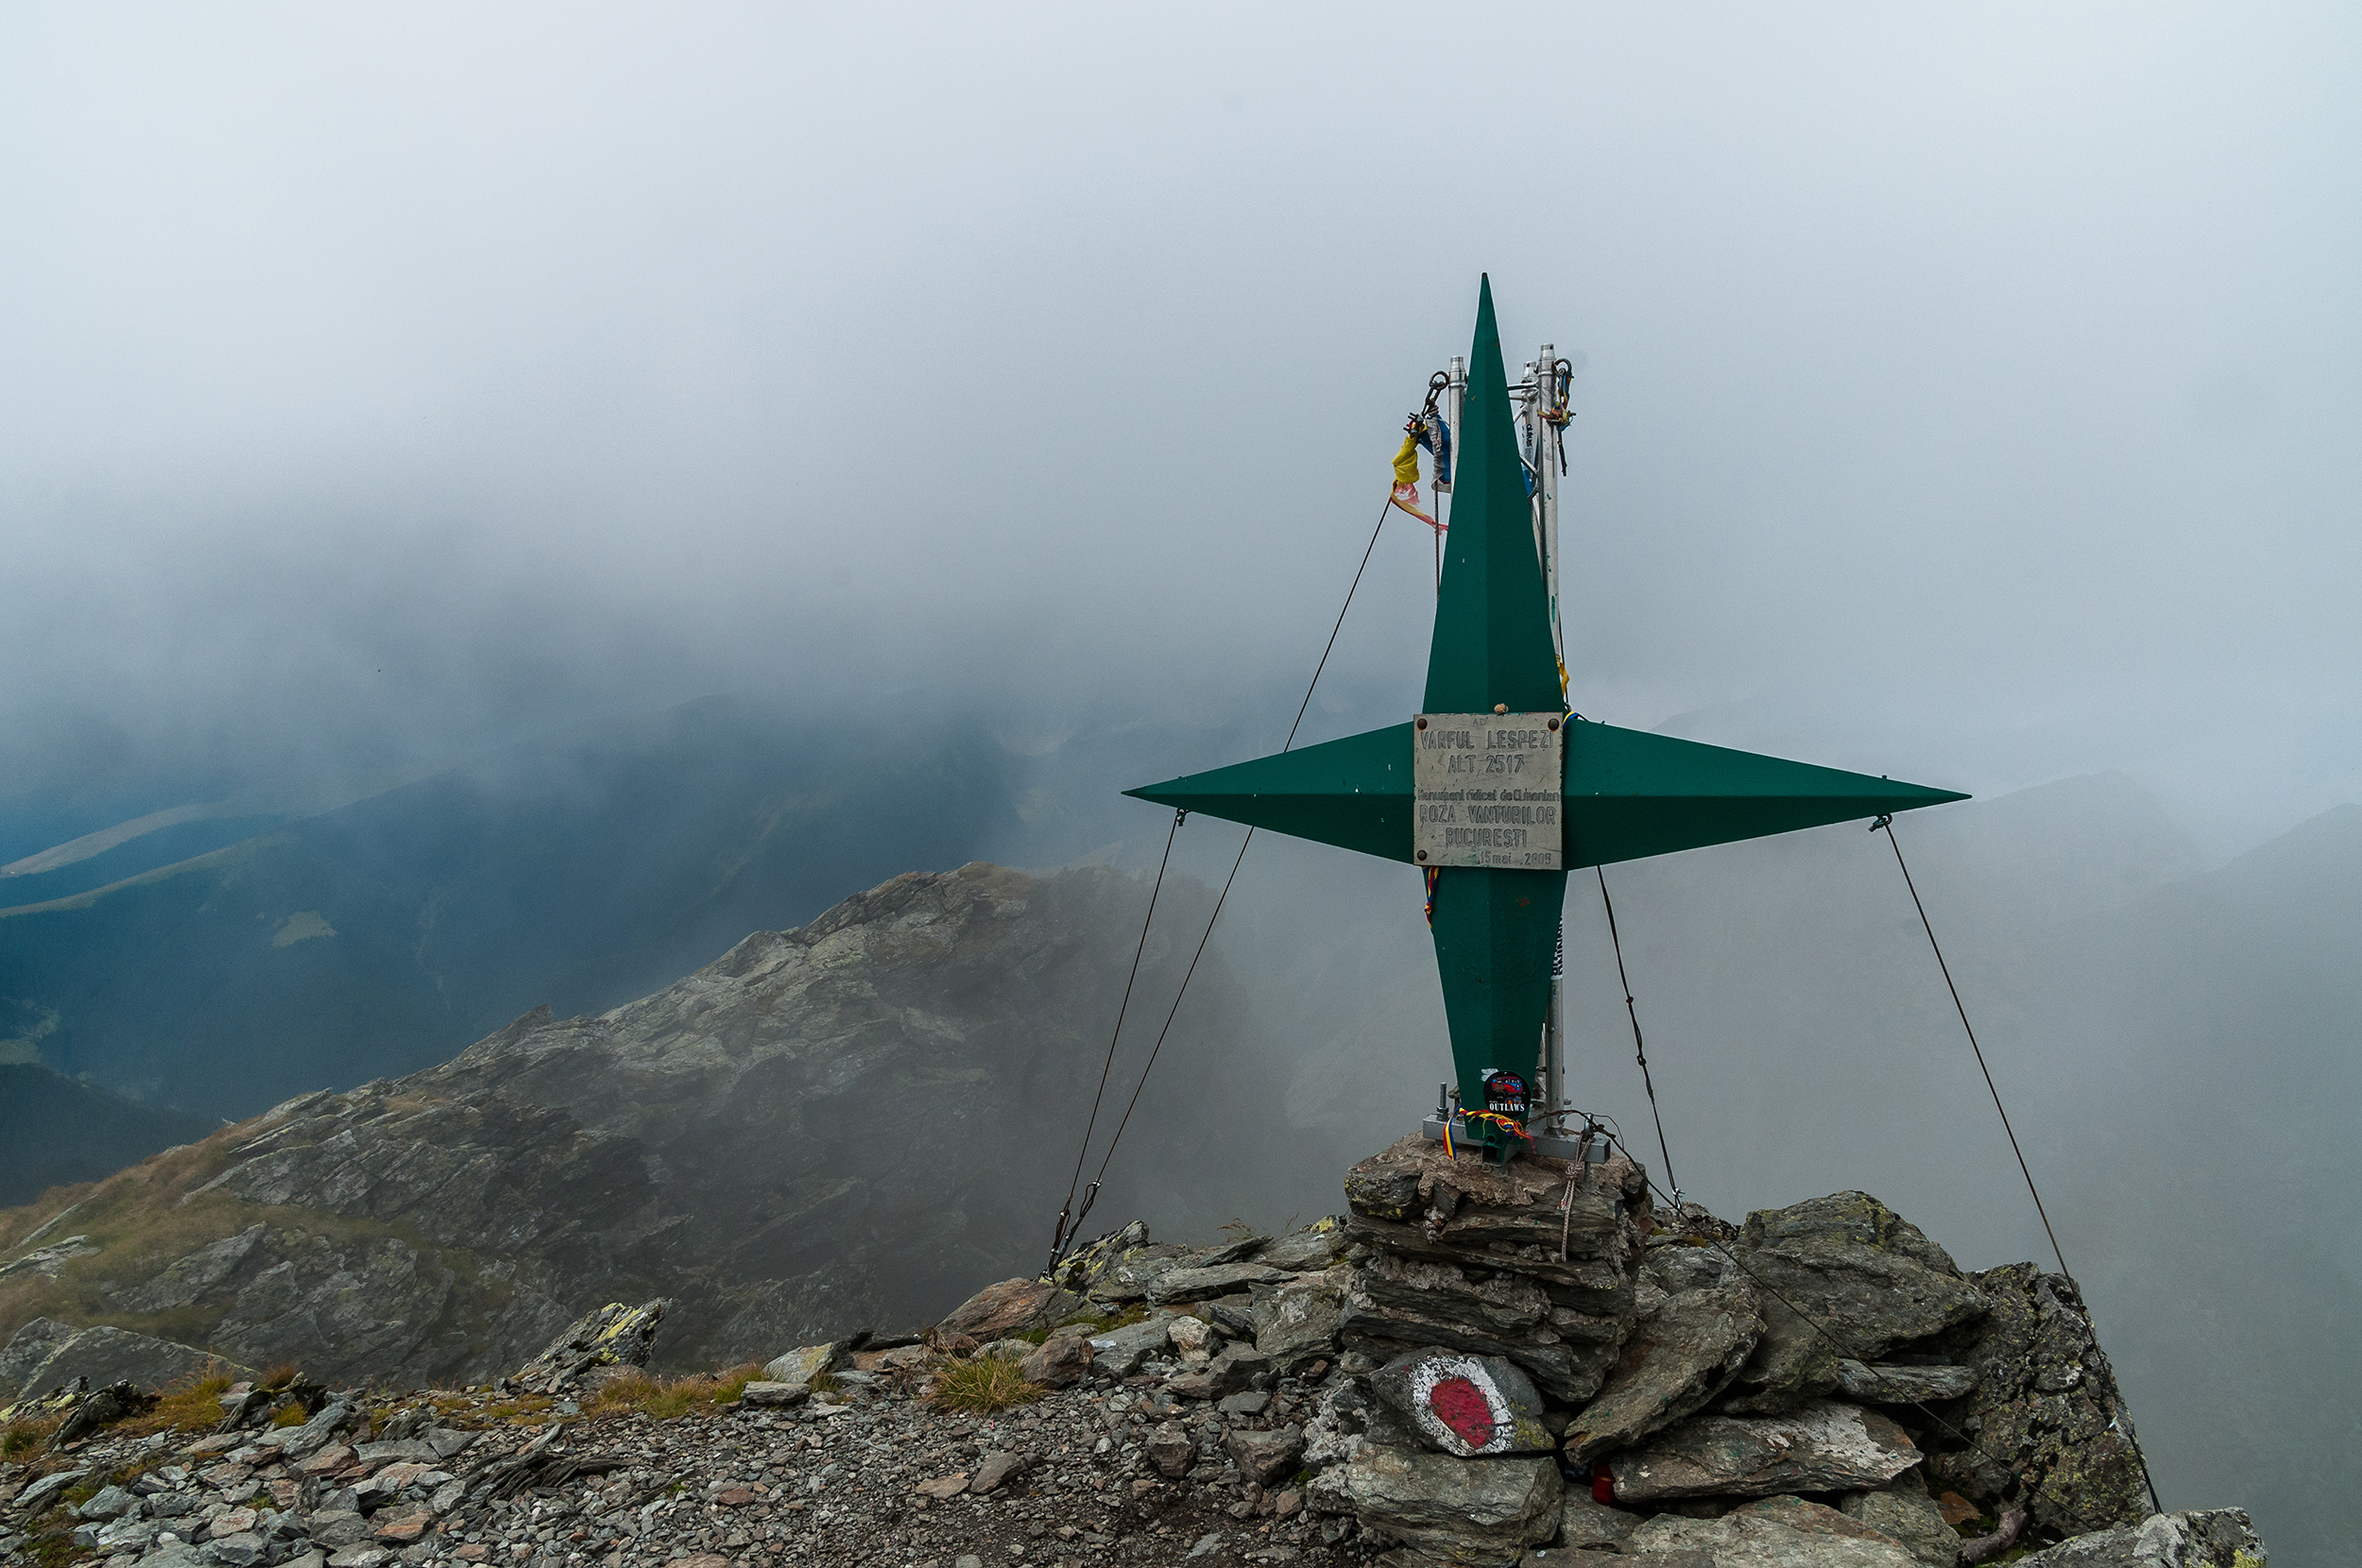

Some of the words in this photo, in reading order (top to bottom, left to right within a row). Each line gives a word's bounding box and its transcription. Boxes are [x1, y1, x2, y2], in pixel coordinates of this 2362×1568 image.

[1420, 730, 1475, 749] VARFUL
[1487, 729, 1554, 749] LESPEZI
[1447, 755, 1476, 774] ALT
[1485, 755, 1524, 774] 2517
[1419, 805, 1456, 823] ROZA
[1467, 806, 1556, 825] VANTURILOR
[1446, 827, 1527, 847] BUCURESTI
[1489, 1102, 1525, 1112] OUTLAWS
